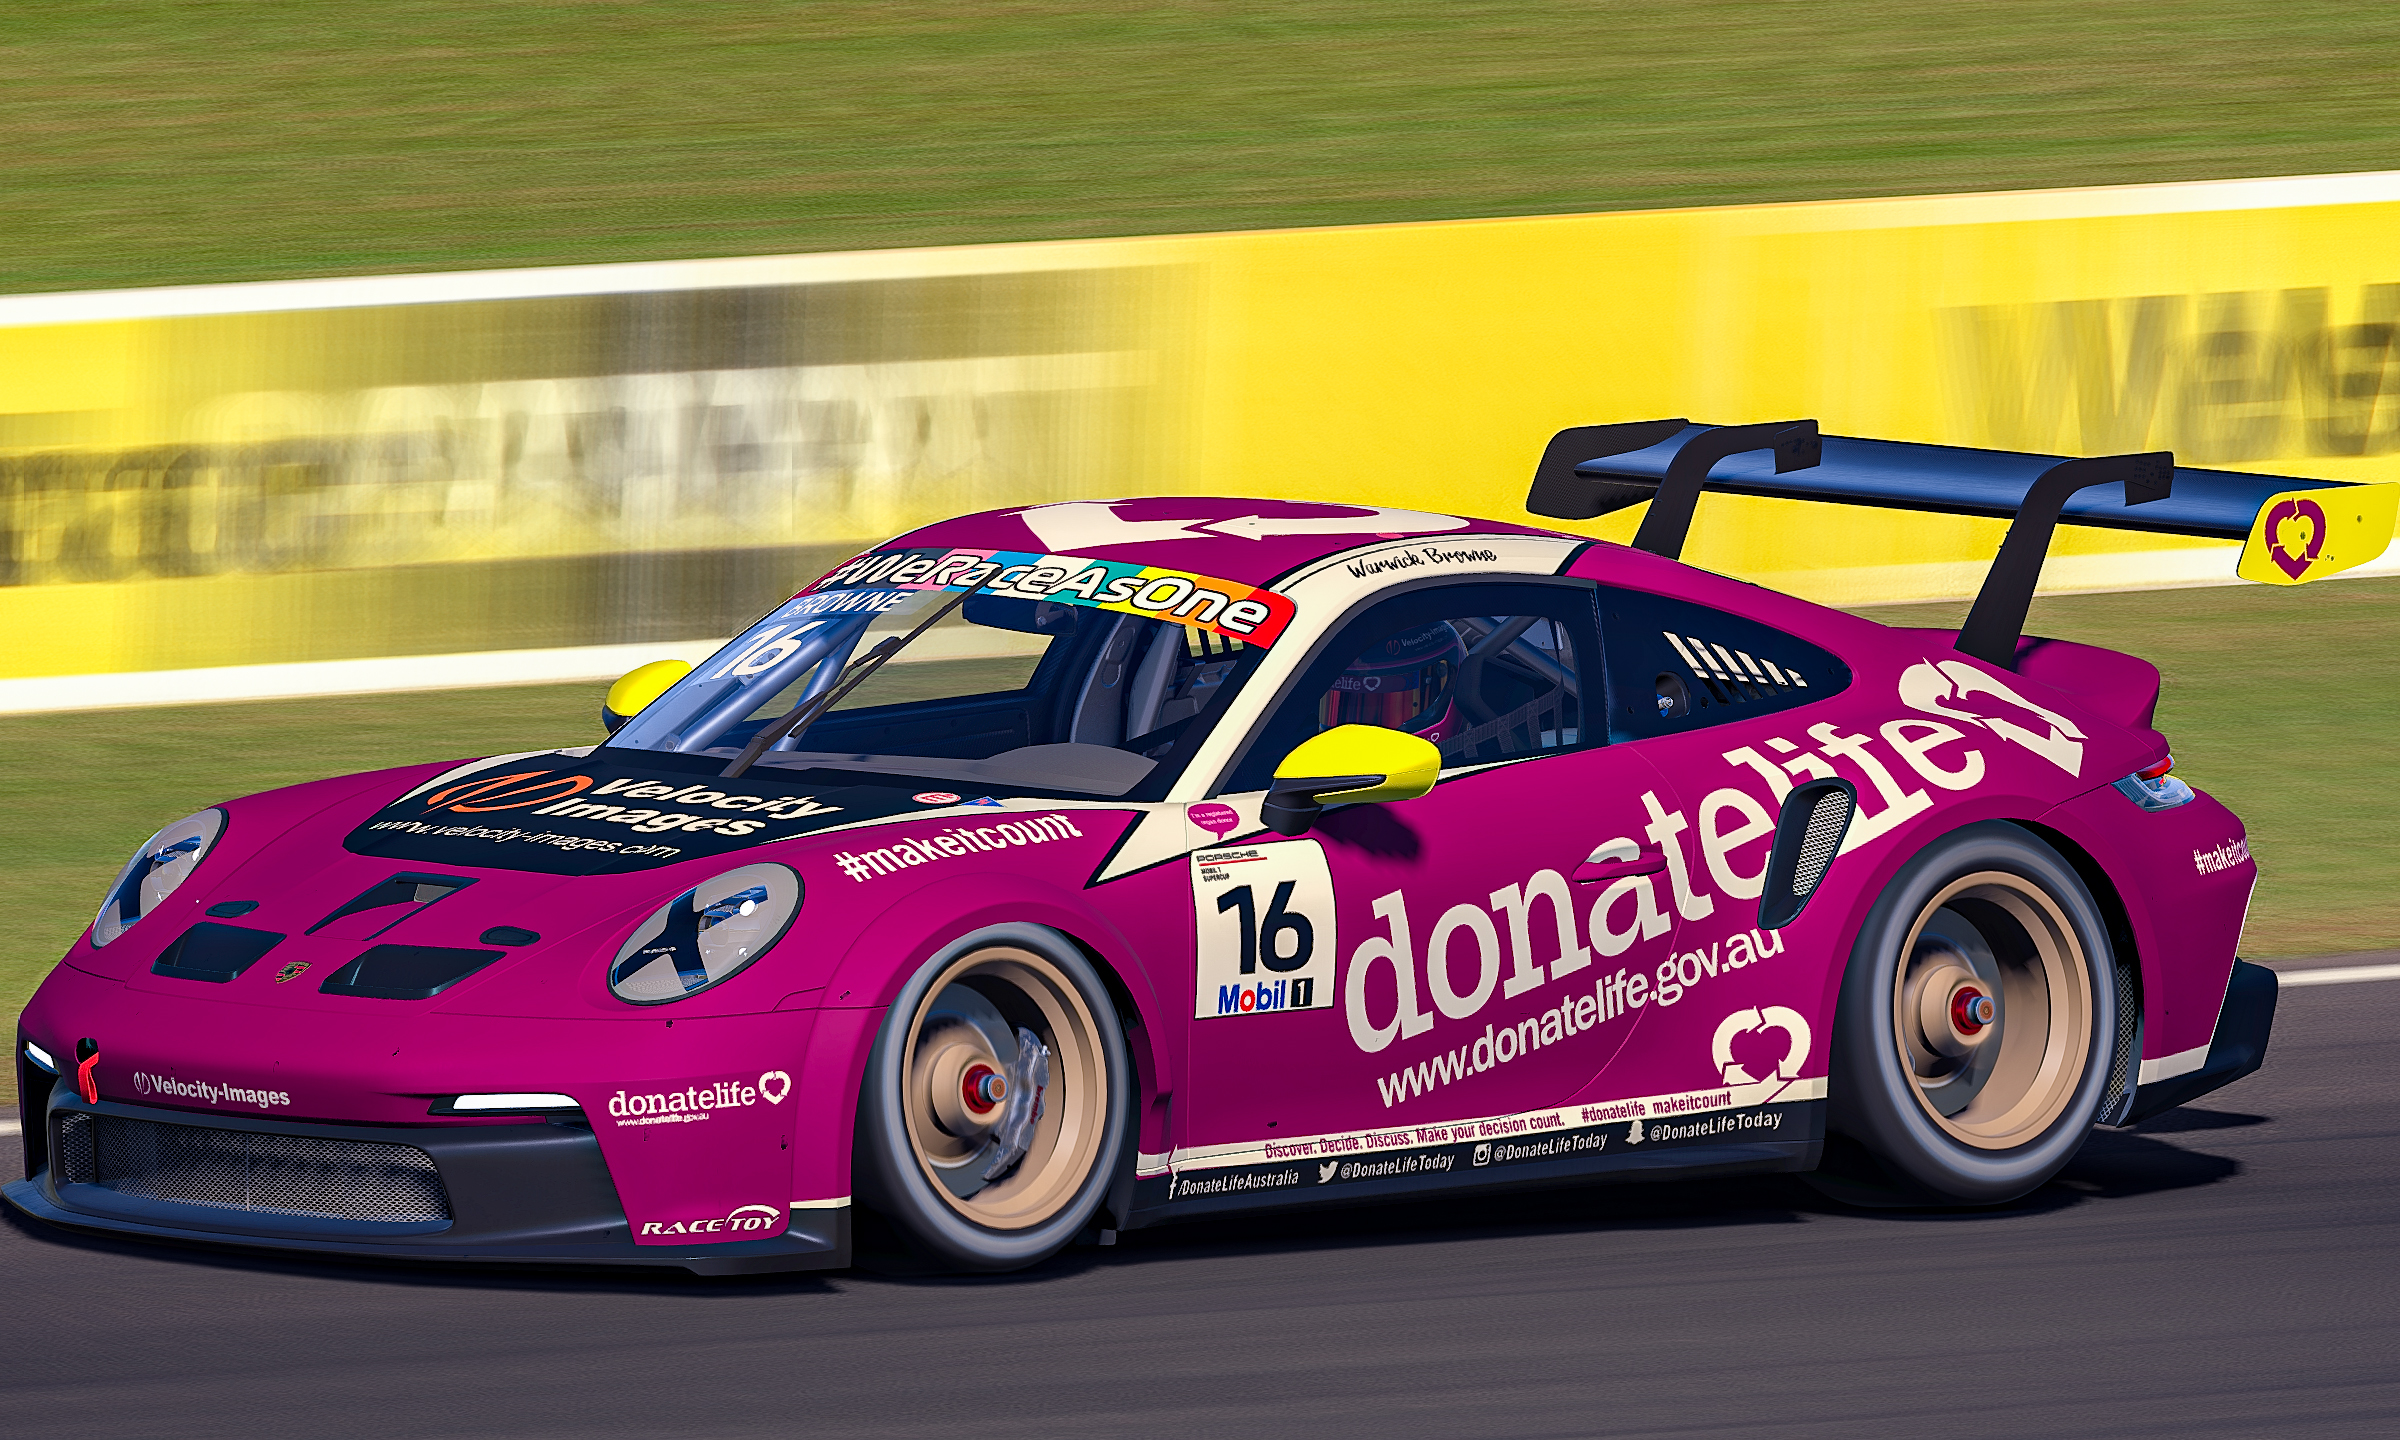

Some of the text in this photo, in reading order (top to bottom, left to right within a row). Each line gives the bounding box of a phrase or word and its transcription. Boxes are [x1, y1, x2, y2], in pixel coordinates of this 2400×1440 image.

[1346, 548, 1497, 579] Warwick Browne
[781, 591, 914, 619] BROWNE
[811, 552, 1269, 632] #WeRaceAsOne
[710, 621, 827, 680] 16
[590, 778, 845, 819] Velocity
[531, 798, 767, 836] Images
[369, 820, 682, 859] www.velocity-images.com
[833, 813, 1083, 882] #makeitcount
[1196, 850, 1259, 863] PORSCHE
[1203, 872, 1230, 882] SUPERCUP
[1216, 879, 1314, 975] 16
[1217, 979, 1287, 1015] Mobil
[1377, 928, 1785, 1110] www.donatelife.gov.au
[150, 1074, 291, 1109] Velocity-Images
[608, 1081, 756, 1117] donatelife
[616, 1112, 710, 1127] www.donatelife.gov.au
[1264, 1090, 1732, 1160] Discover. Decide. Discuss. Make your decision count. #donatelife makeitcount
[1650, 1110, 1783, 1142] @DonateLifeToday
[1494, 1131, 1608, 1162] @DonateLifeToday
[1177, 1168, 1300, 1197] /DonateLifeAustralia
[1340, 1152, 1455, 1181] @DonateLifeToday
